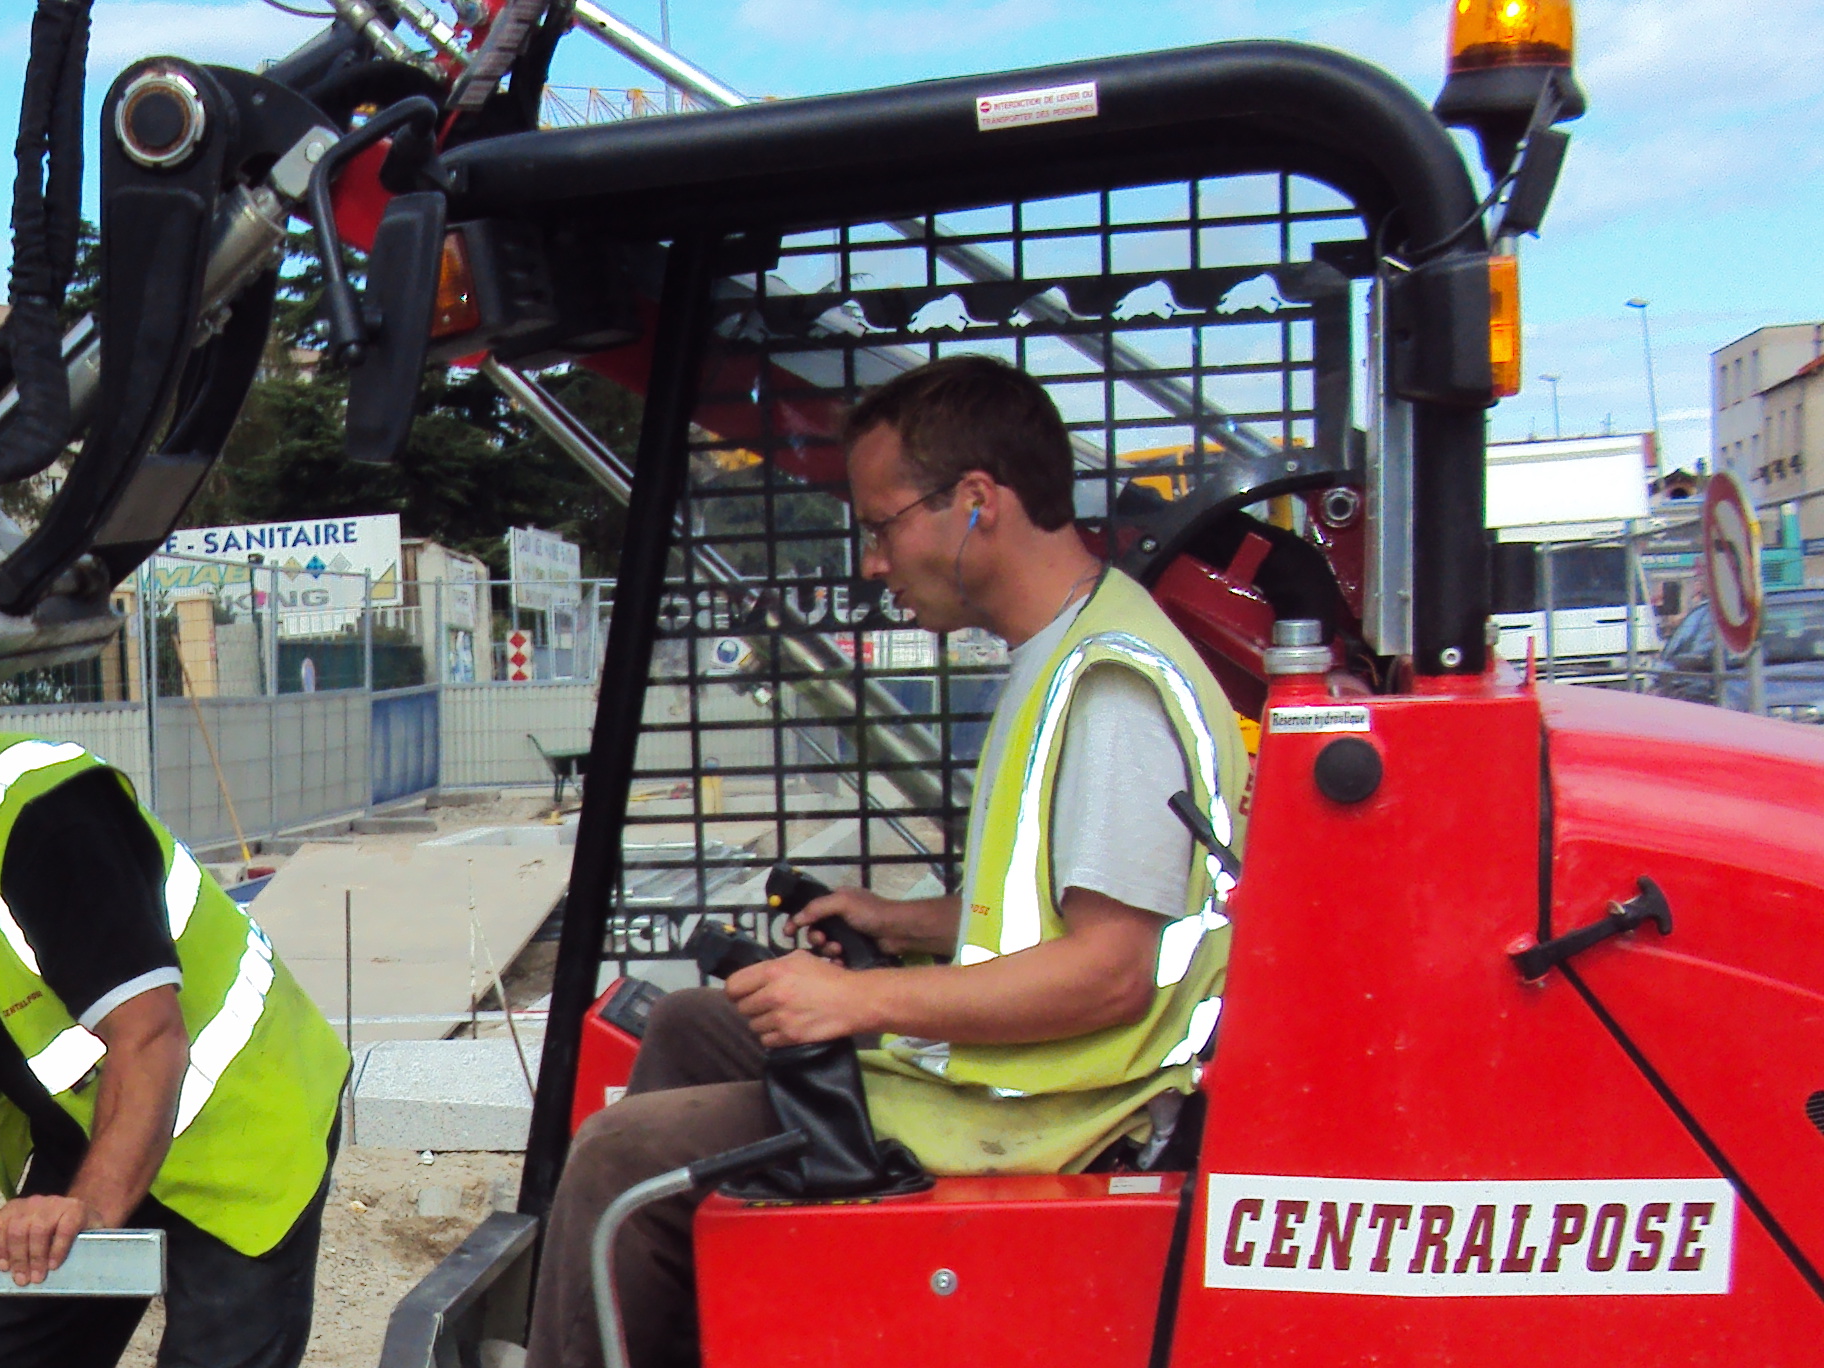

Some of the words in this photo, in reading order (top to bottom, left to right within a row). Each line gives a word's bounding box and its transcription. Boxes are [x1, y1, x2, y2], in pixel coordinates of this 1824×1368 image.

[993, 99, 1042, 111] INTERDICTION
[1043, 95, 1054, 105] DE
[1056, 91, 1080, 103] LEVER
[1081, 89, 1094, 99] OU
[1035, 109, 1050, 119] DES
[204, 521, 358, 555] SANITAIRE
[1223, 1198, 1716, 1275] CENTRALPOSE
